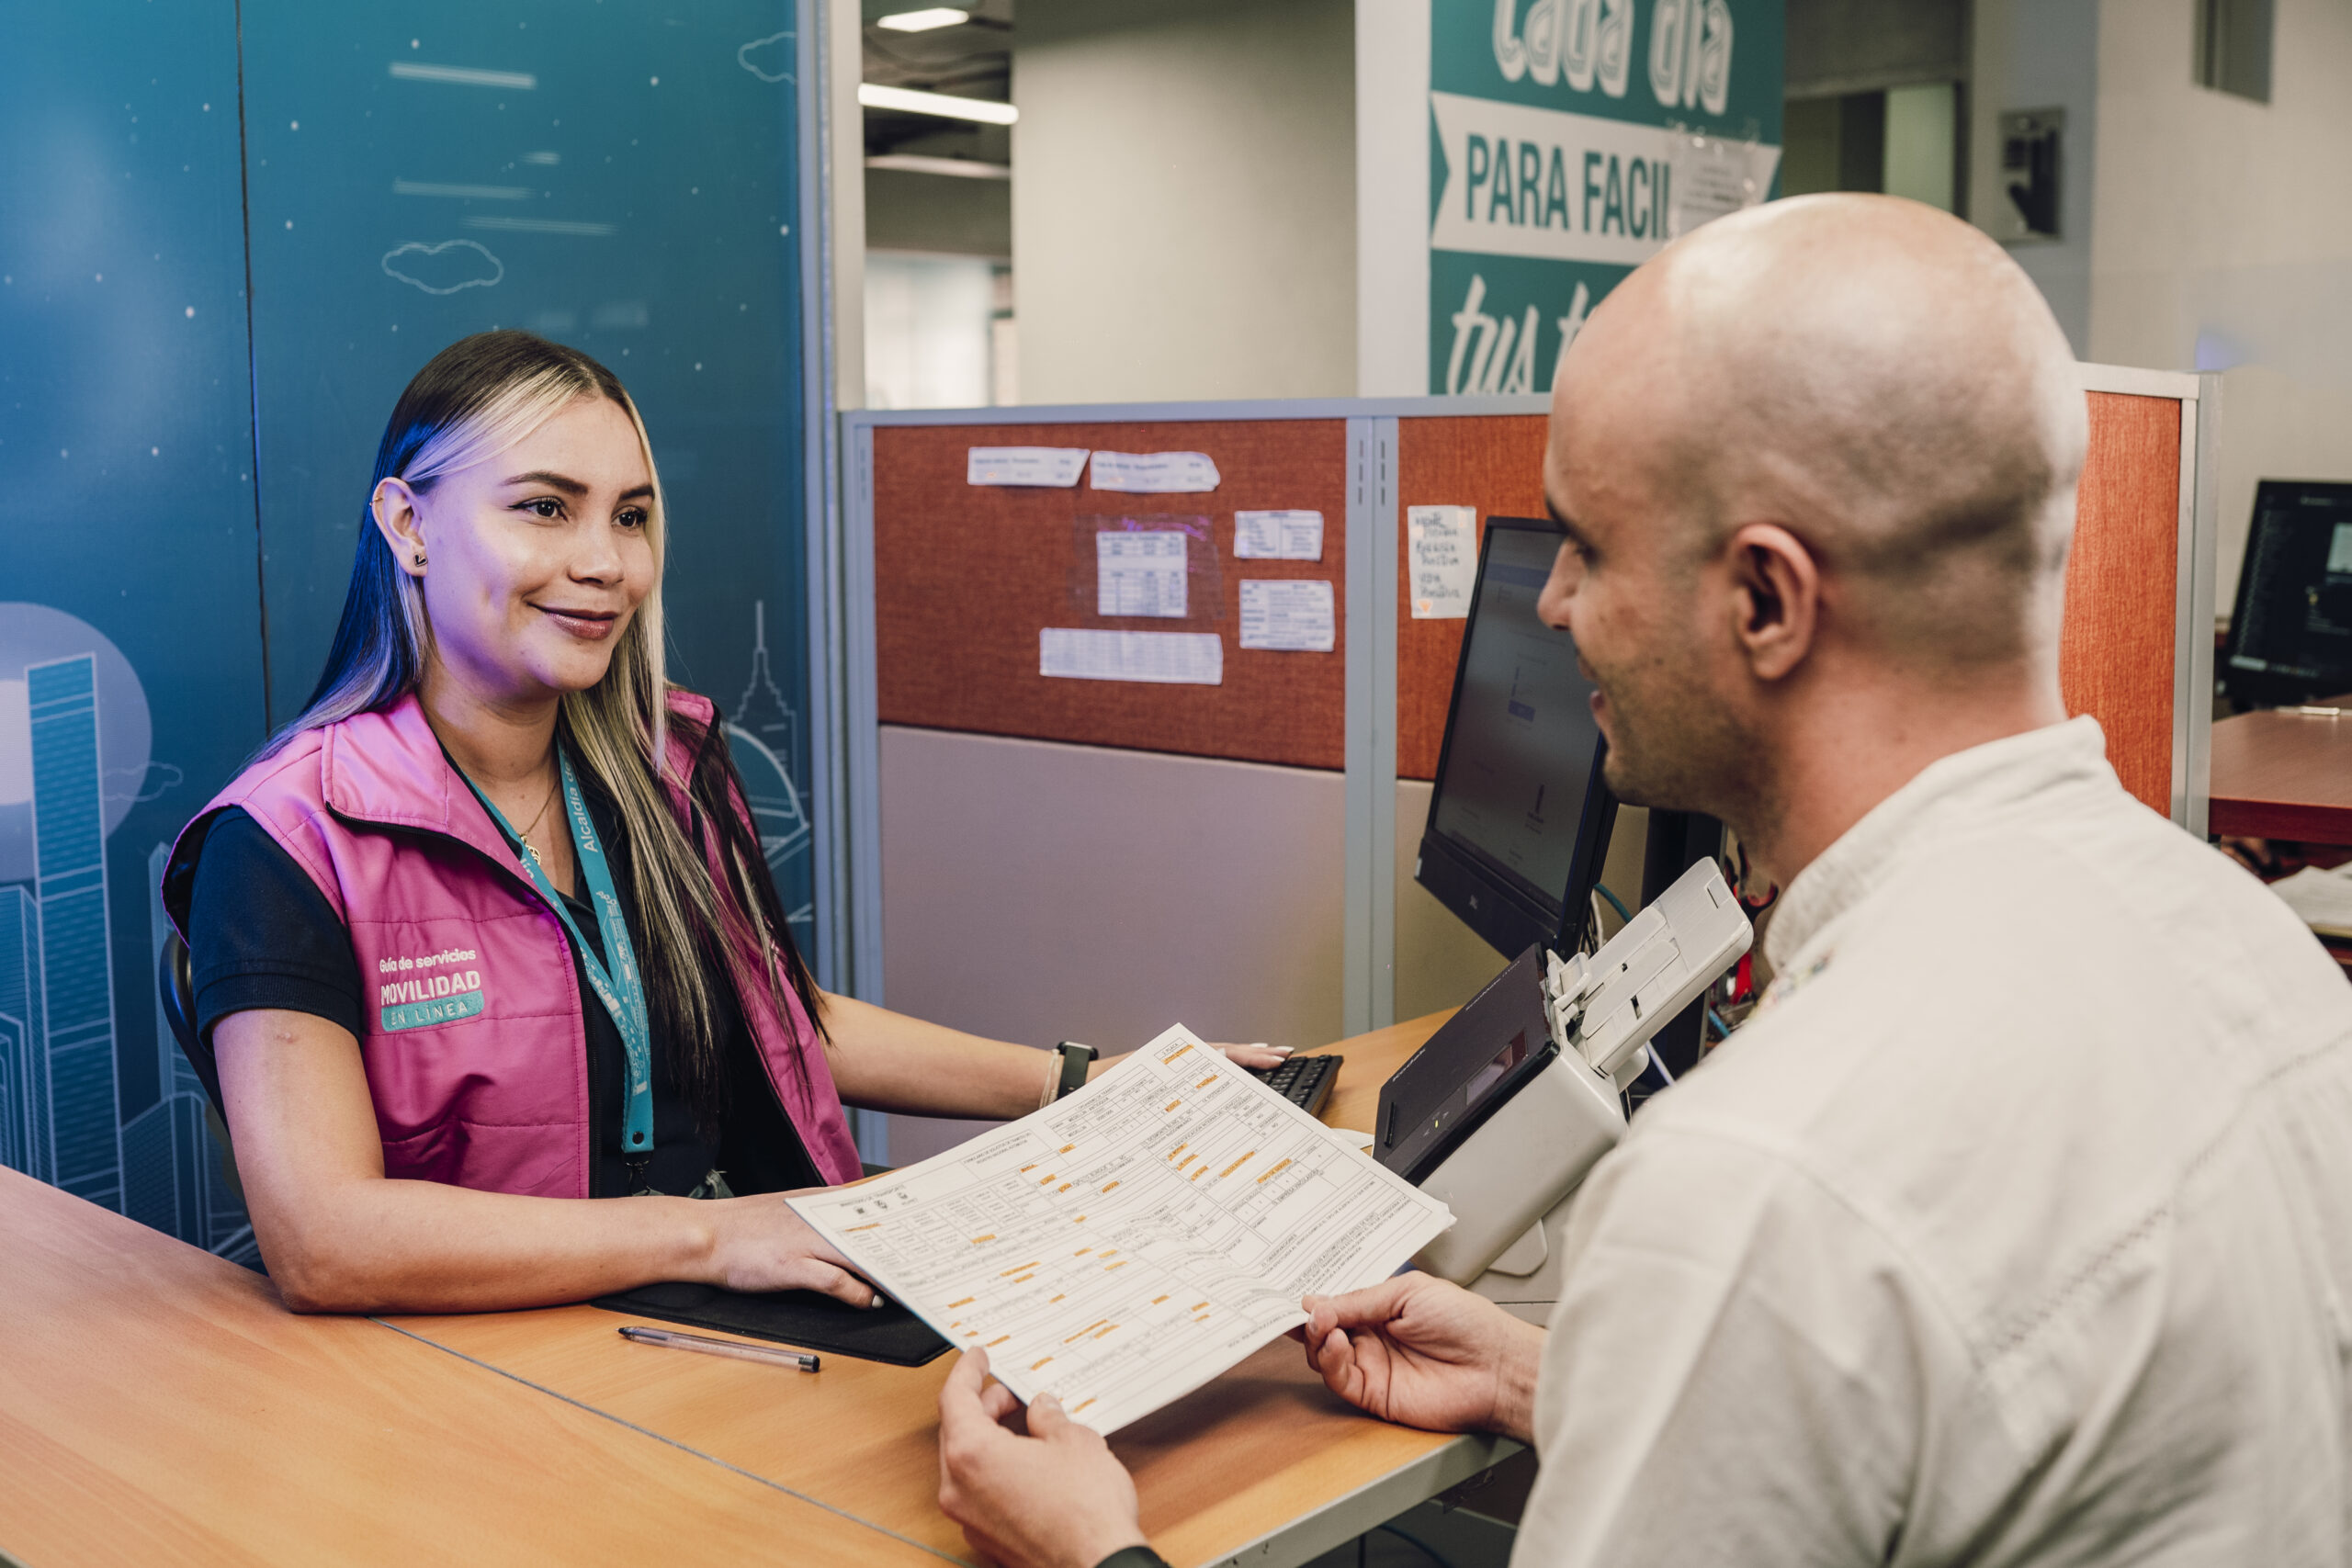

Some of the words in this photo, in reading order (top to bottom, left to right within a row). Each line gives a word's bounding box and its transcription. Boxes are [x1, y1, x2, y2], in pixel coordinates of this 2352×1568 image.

[1465, 132, 1570, 231] PARA
[379, 957, 398, 974] Guía
[398, 955, 413, 971] de
[415, 948, 477, 968] servicios
[380, 970, 481, 1006] MOVILIDAD
[390, 1010, 406, 1026] EN
